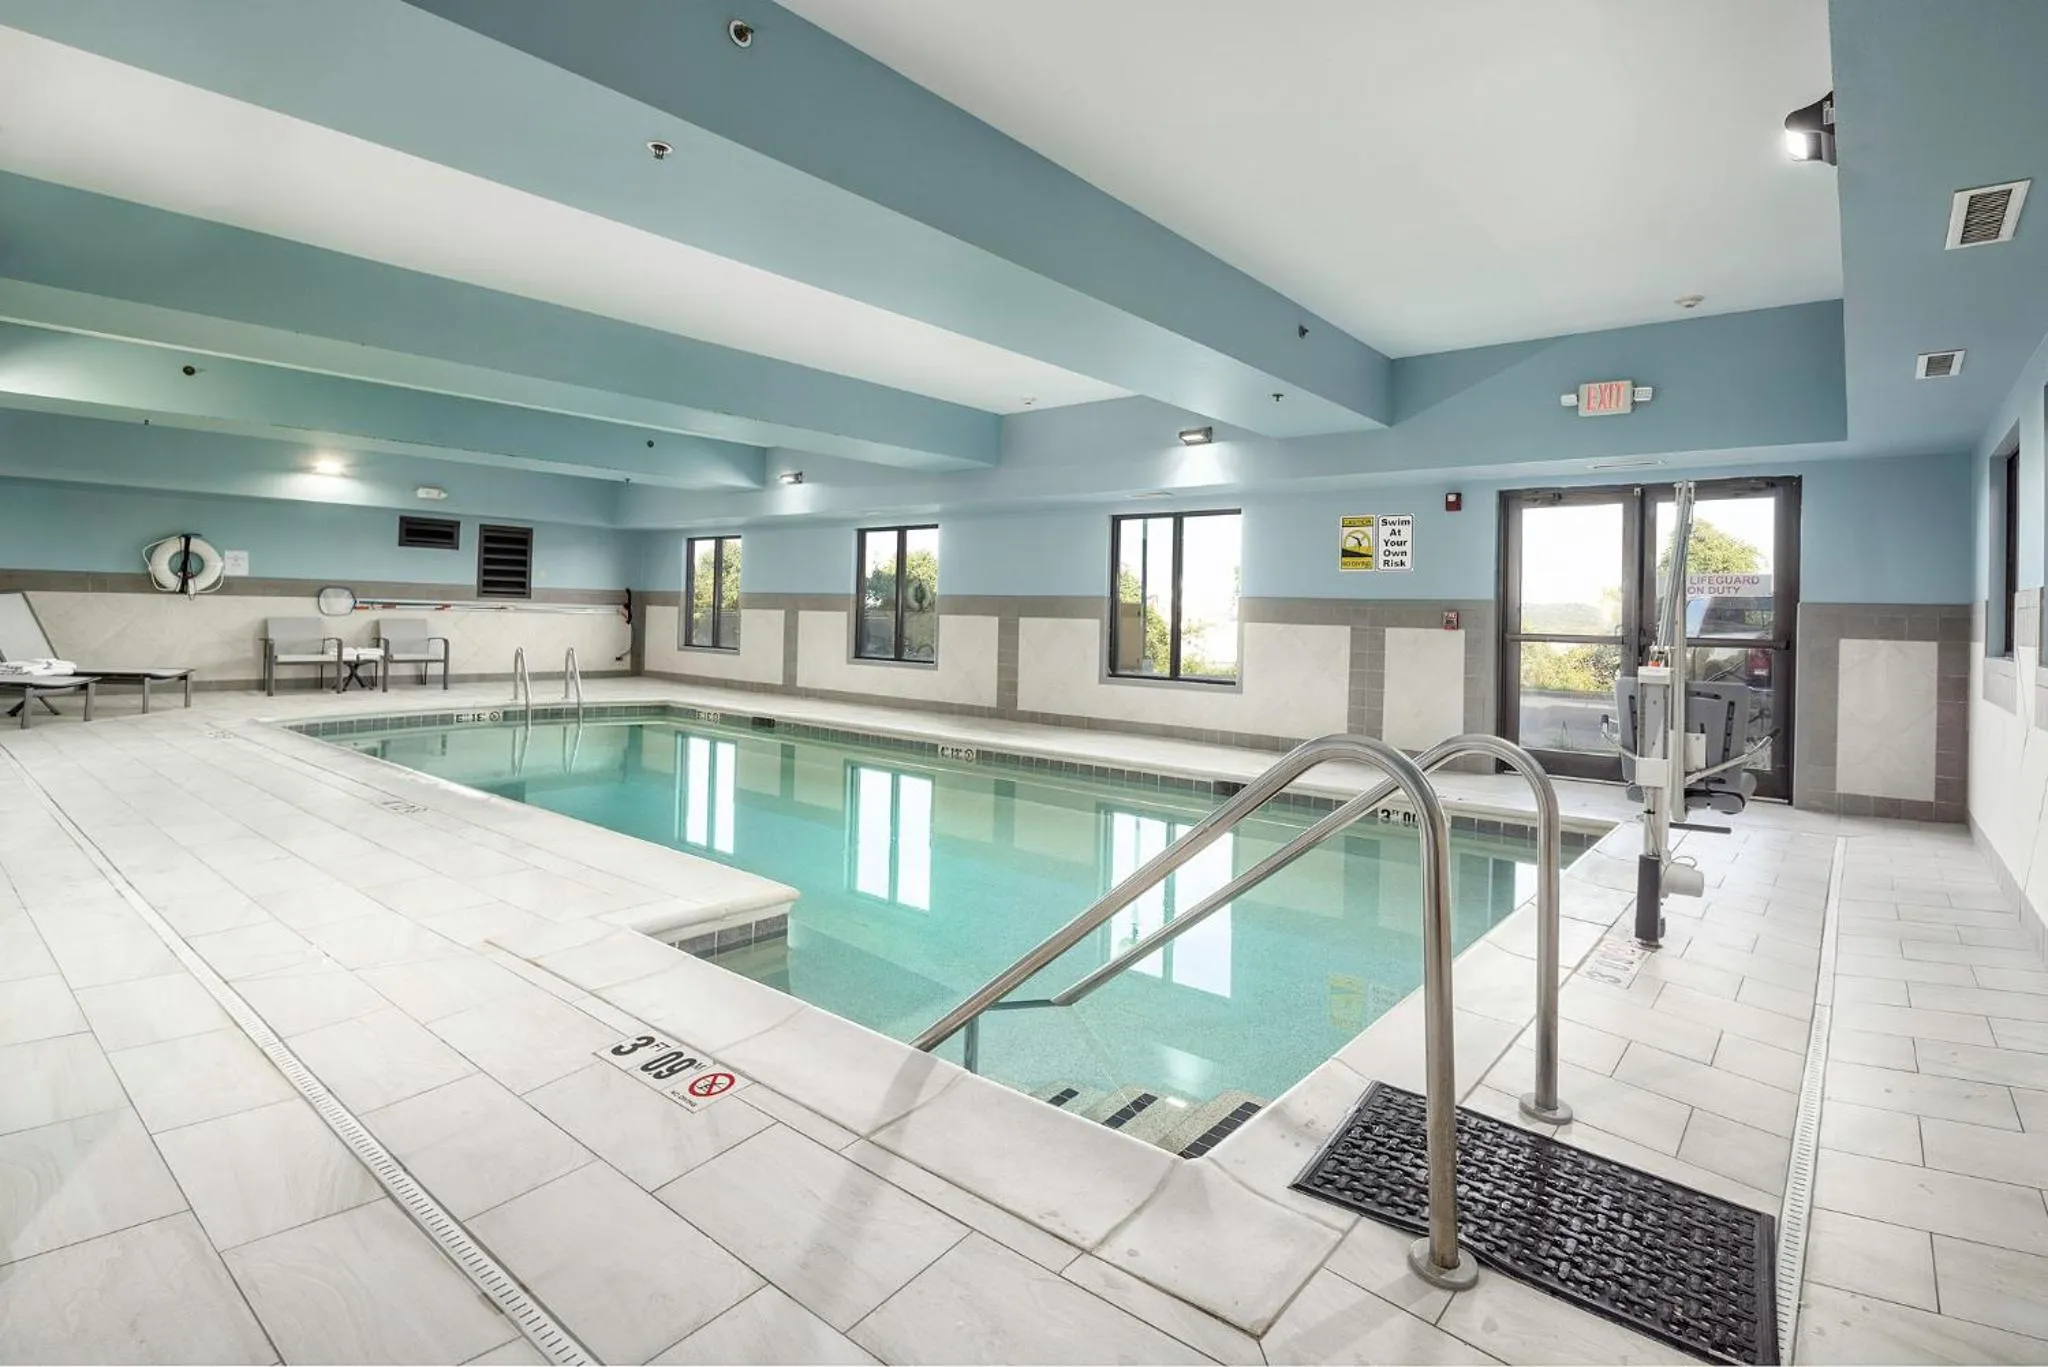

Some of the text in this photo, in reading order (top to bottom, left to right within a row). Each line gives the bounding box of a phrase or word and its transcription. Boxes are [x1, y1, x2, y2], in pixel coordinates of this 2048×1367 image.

[1586, 382, 1625, 412] EXIT
[1381, 518, 1411, 527] Swim
[1389, 528, 1402, 537] At
[1383, 538, 1408, 547] Your
[1383, 549, 1408, 557] Own
[1382, 559, 1406, 568] Risk
[1689, 575, 1760, 586] LIFEGUARD
[1687, 586, 1741, 595] ON DUTY
[611, 1036, 656, 1056] 3
